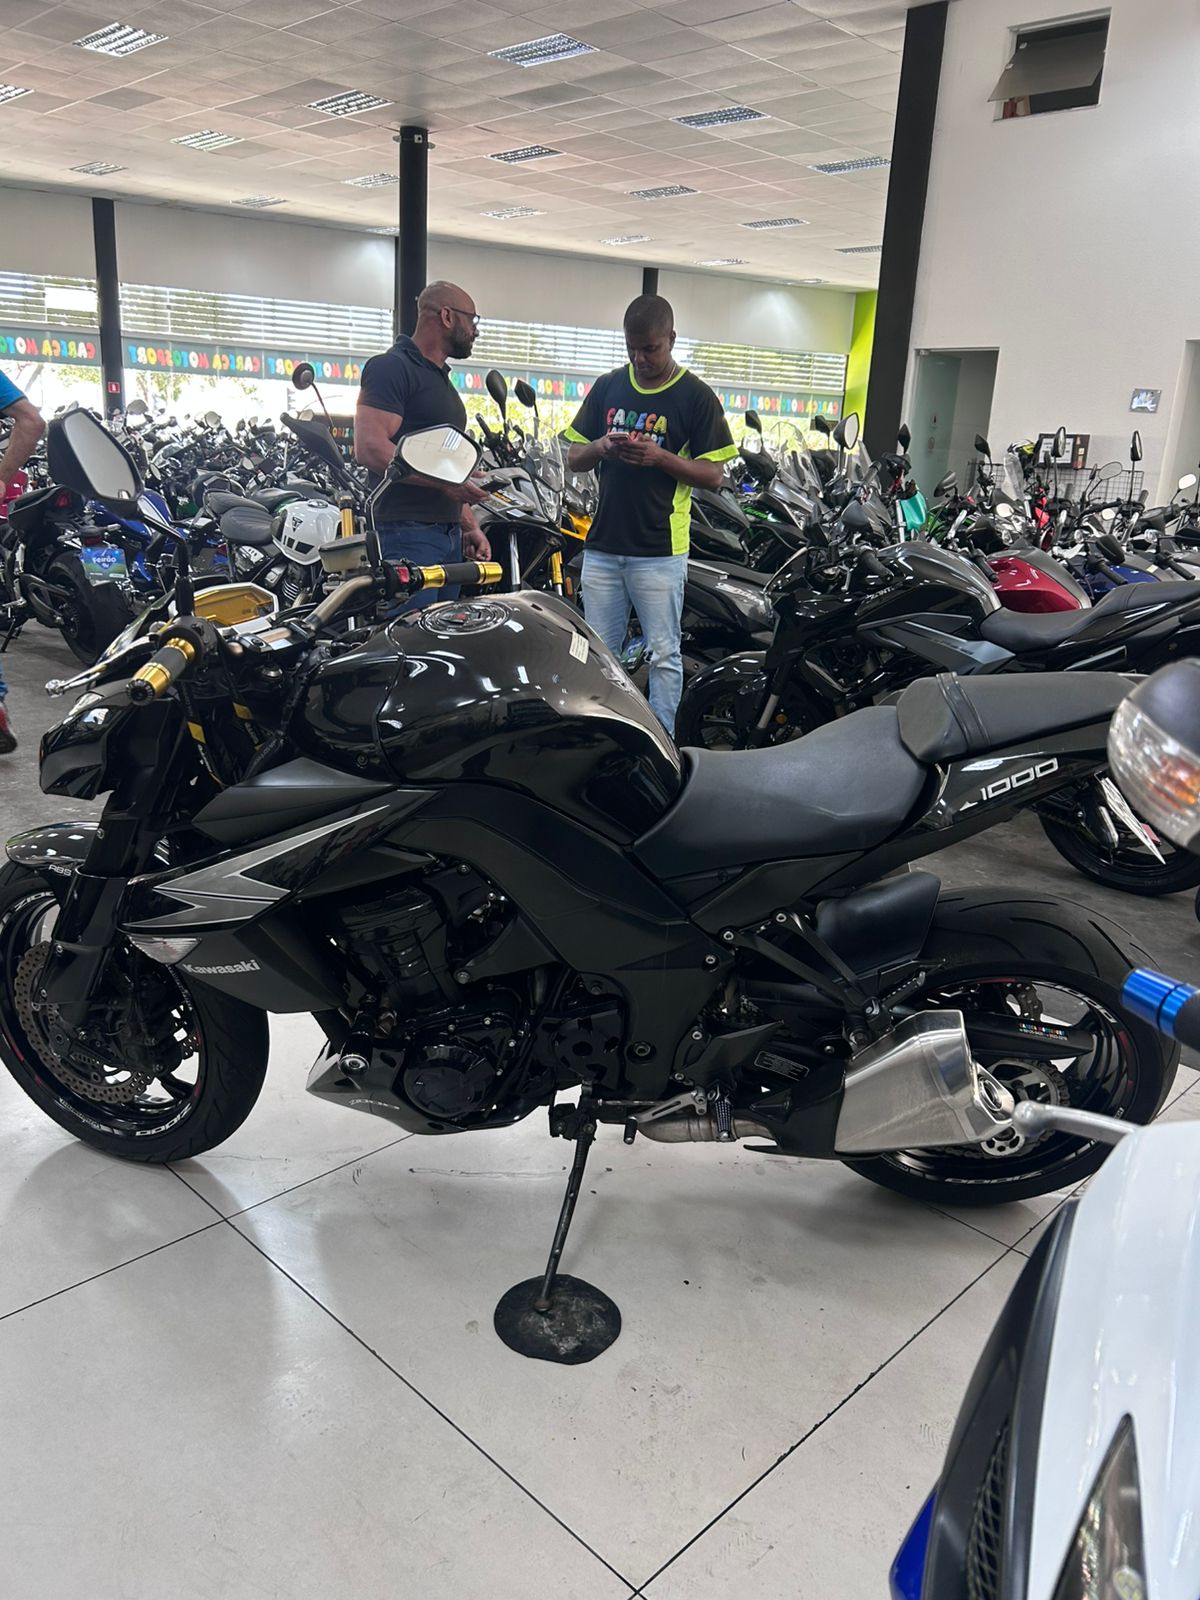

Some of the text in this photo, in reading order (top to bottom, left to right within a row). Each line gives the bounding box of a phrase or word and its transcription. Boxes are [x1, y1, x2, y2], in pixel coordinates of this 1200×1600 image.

[606, 407, 668, 434] CARECA
[980, 757, 1059, 801] 1000
[48, 864, 73, 877] ABS
[182, 959, 262, 975] Kawasaki
